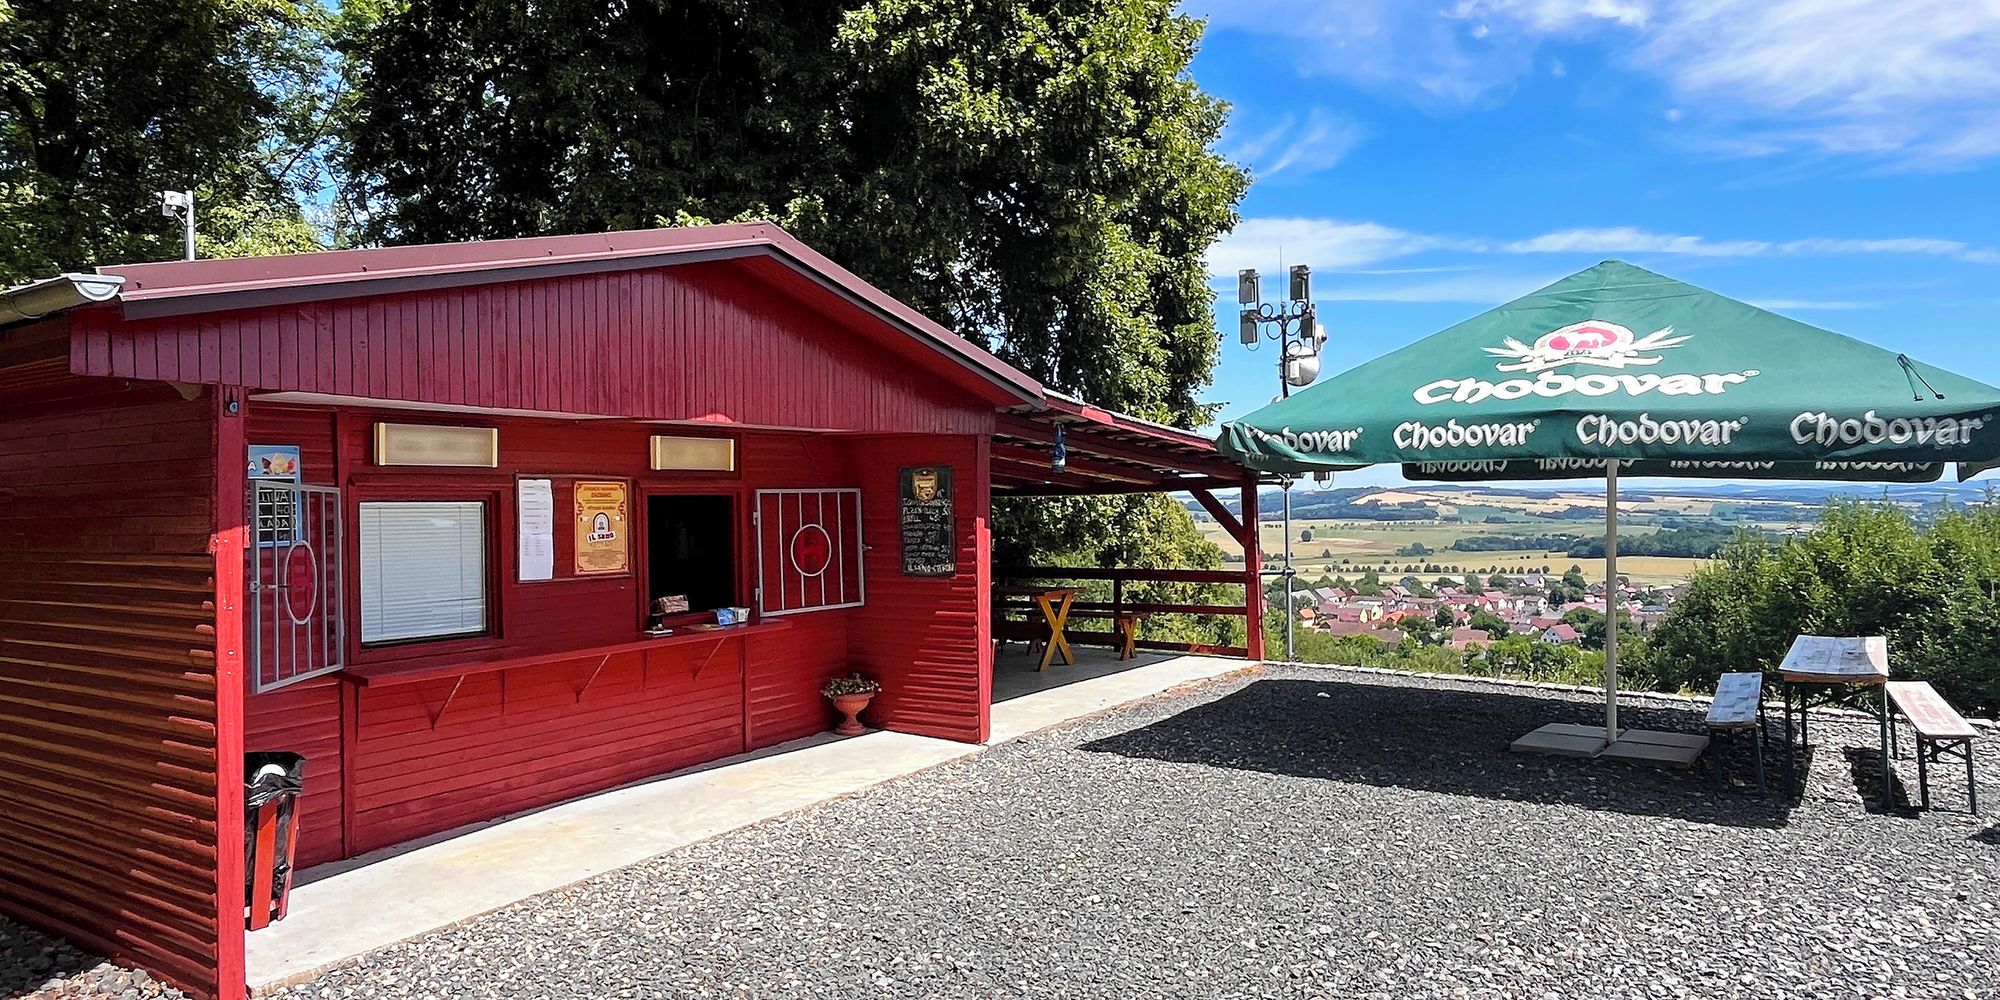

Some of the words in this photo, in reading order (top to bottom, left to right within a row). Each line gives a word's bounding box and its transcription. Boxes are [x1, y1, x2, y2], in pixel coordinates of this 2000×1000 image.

[1412, 370, 1748, 405] Chodovar
[1393, 419, 1535, 451] Chodovar
[1576, 413, 1741, 447] Chodovar
[1789, 410, 1984, 447] Chodovar
